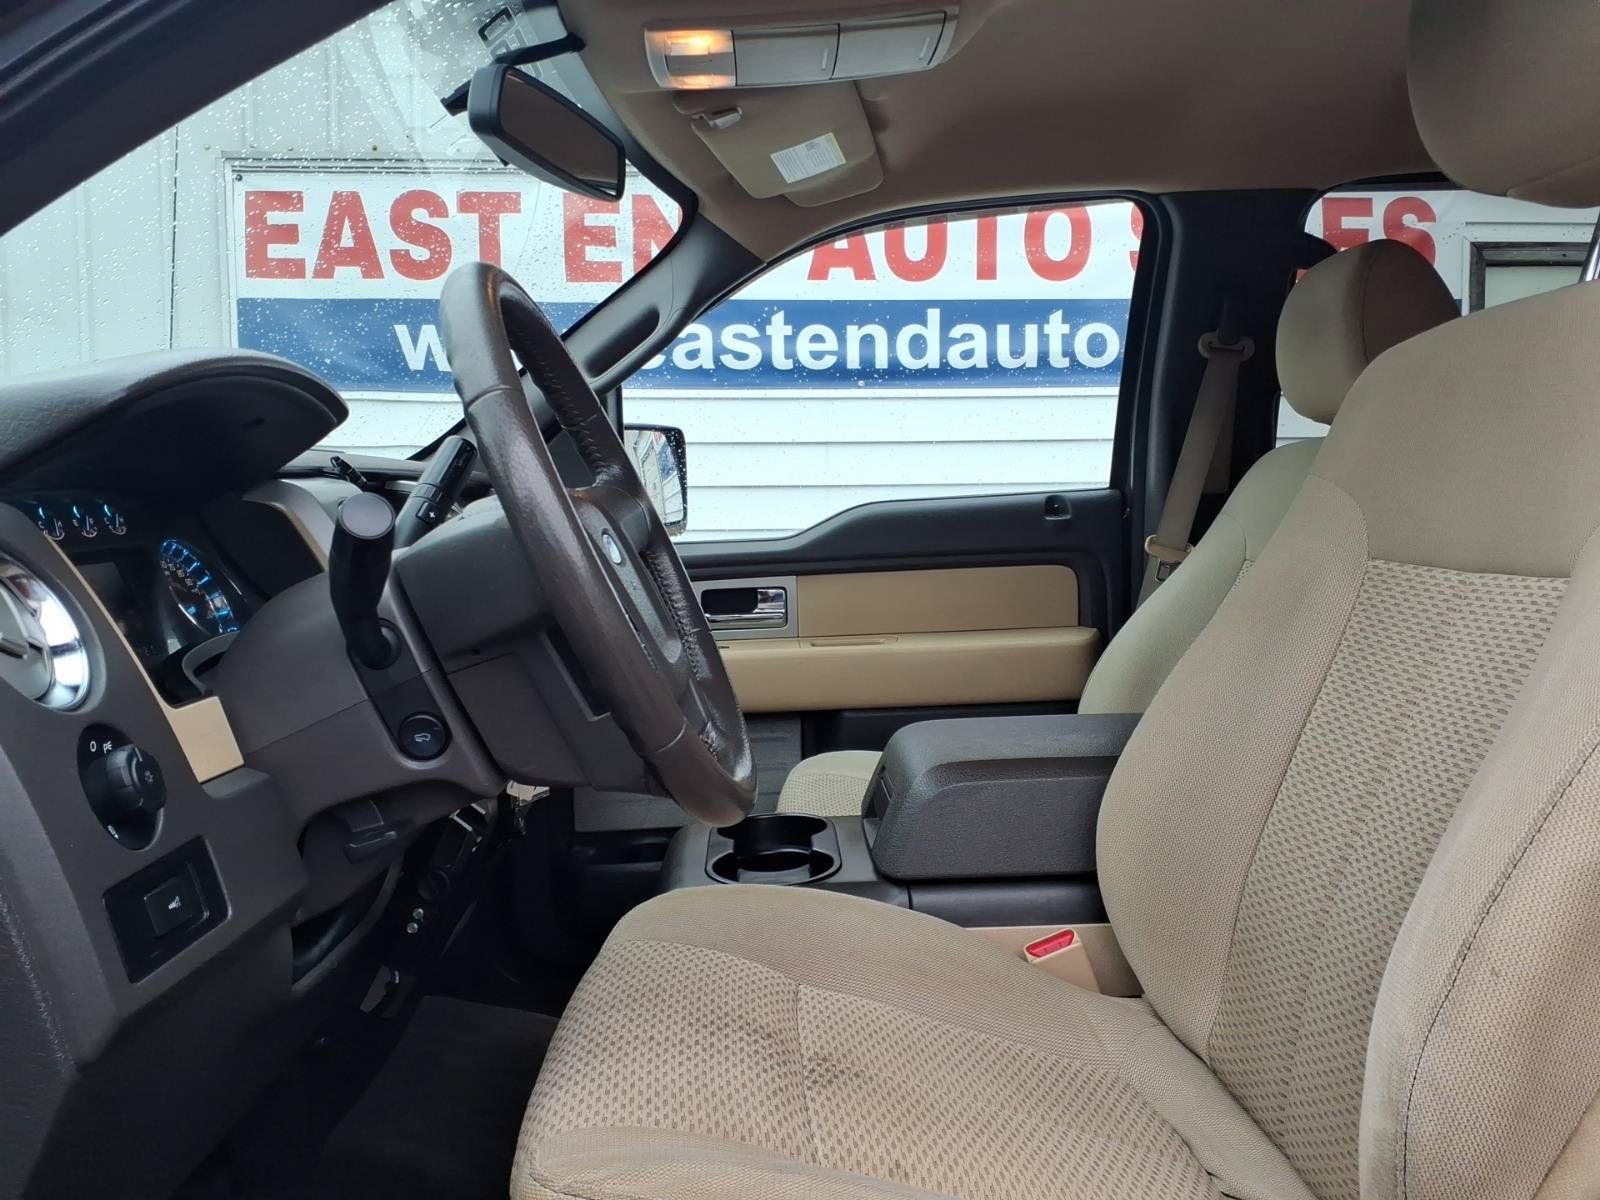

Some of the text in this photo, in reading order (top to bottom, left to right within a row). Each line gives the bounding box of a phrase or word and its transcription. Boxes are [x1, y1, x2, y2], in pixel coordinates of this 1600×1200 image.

[245, 190, 521, 281] EAST
[563, 192, 683, 282] EN
[807, 202, 1092, 282] AUTO
